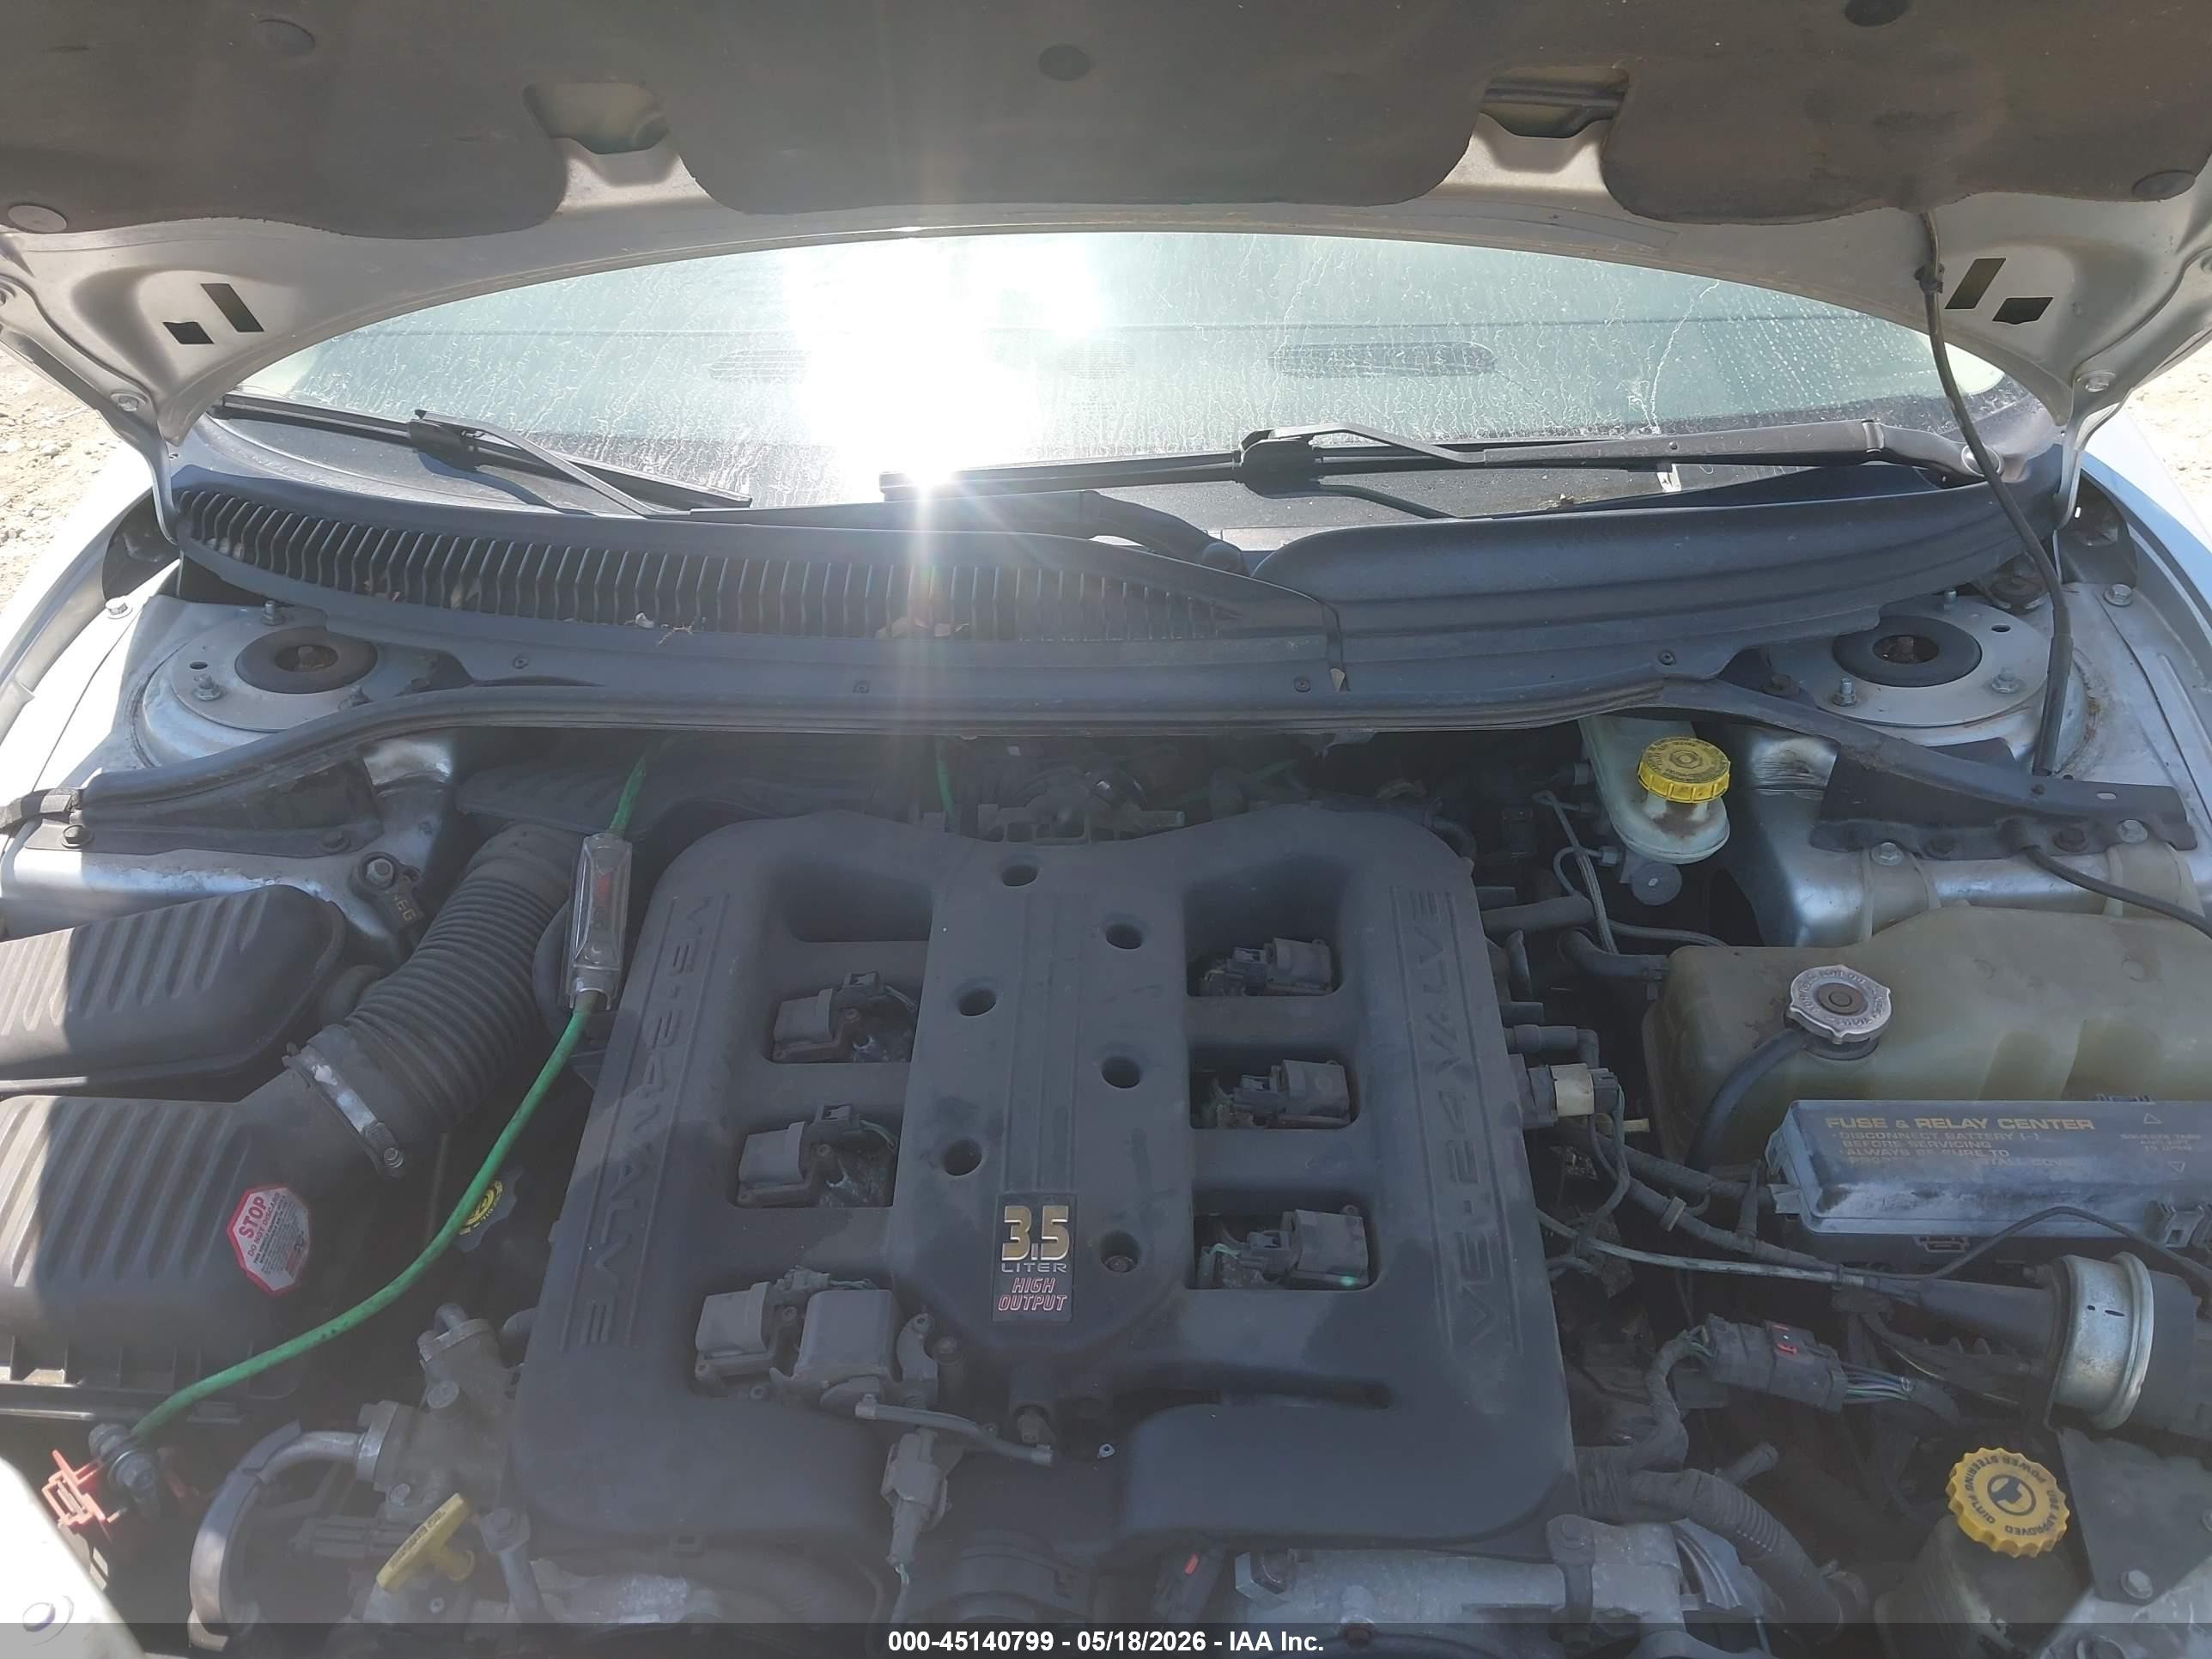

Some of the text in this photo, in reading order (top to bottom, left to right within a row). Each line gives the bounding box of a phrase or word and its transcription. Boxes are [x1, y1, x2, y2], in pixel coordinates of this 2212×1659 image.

[1826, 1117, 2095, 1130] FUSE & RELAY CENTER
[1839, 1132, 1938, 1140] DISCONNECT
[1944, 1132, 2014, 1140] BATTERY
[1908, 1140, 1992, 1149] SERVICING
[1990, 1149, 2010, 1158] TO
[239, 1196, 267, 1238] STOP
[1001, 1206, 1070, 1261] 3.5
[248, 1243, 258, 1257] DO
[254, 1227, 265, 1243] NOT
[1001, 1262, 1067, 1273] LITER
[1012, 1277, 1055, 1293] HIGH
[998, 1294, 1067, 1311] OUTPUT
[1965, 1455, 2047, 1524] POWER STEERING FLUID
[2005, 1490, 2060, 1536] USE APPROVED
